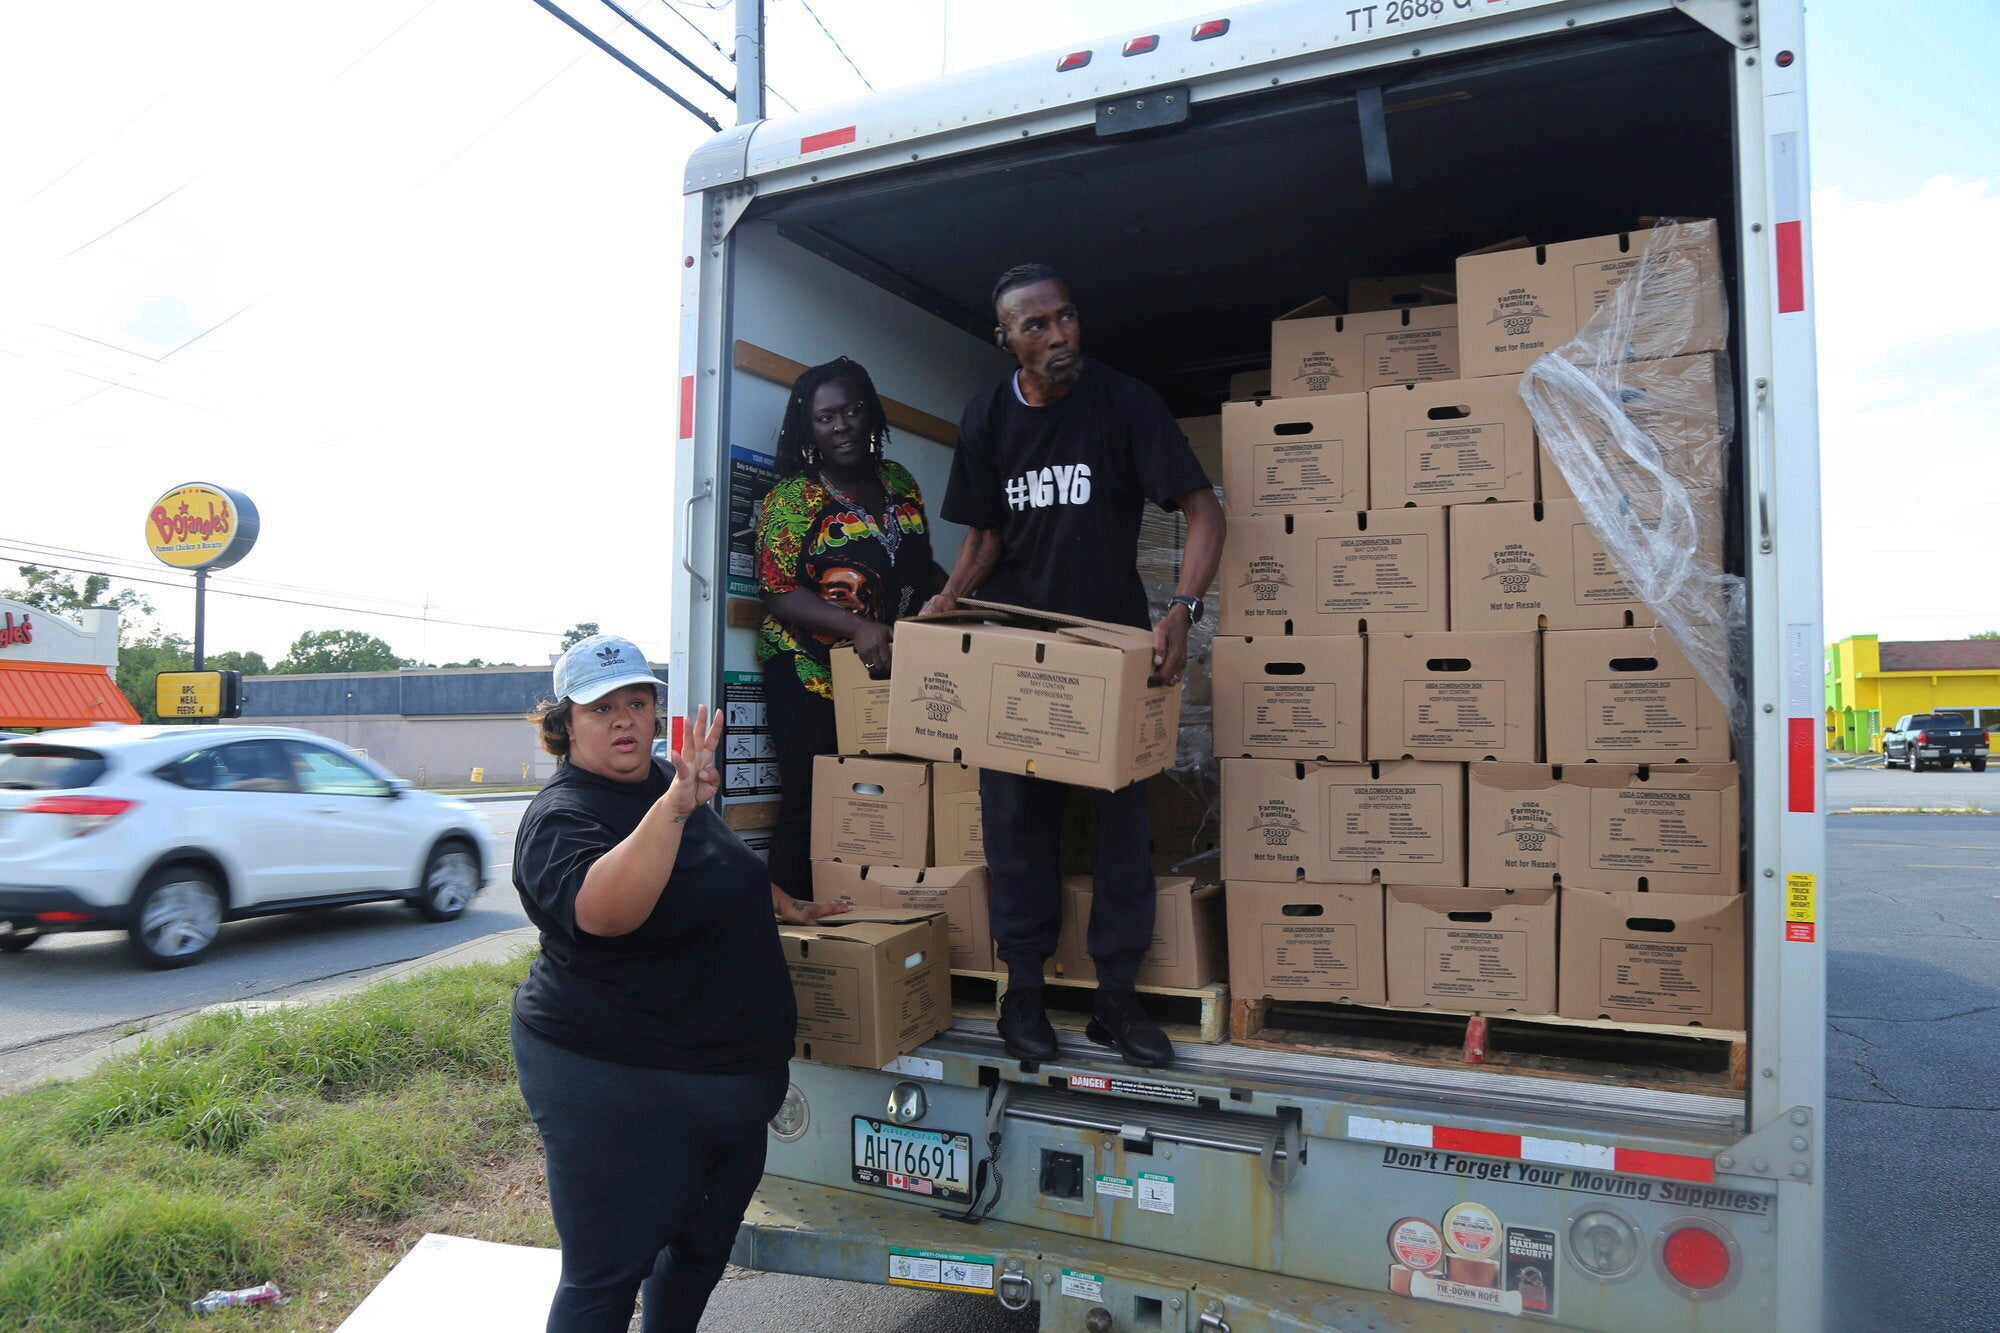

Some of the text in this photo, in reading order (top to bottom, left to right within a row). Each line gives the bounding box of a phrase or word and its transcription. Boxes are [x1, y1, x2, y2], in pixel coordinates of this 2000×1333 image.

[1346, 0, 1444, 32] TT 2688
[1497, 293, 1531, 303] Farmers
[1500, 299, 1534, 310] Families
[1503, 317, 1533, 328] FOOD
[1507, 325, 1531, 335] BOX
[1494, 340, 1544, 353] Not for Resale
[1306, 376, 1330, 384] FOOD
[1308, 382, 1328, 391] BOX
[1004, 463, 1092, 512] #IGY6
[1359, 553, 1398, 561] REFRIGERATED
[1494, 550, 1528, 558] Farmers
[1249, 560, 1278, 568] Farmers
[1496, 556, 1531, 565] Families
[1250, 566, 1281, 575] Families
[1499, 575, 1530, 585] FOOD
[1253, 584, 1279, 593] FOOD
[1504, 583, 1527, 594] BOX
[1256, 591, 1277, 601] BOX
[1490, 601, 1541, 611] Not for Resale
[1266, 608, 1288, 616] Resale
[600, 659, 625, 668] adidas
[933, 671, 949, 679] USDA
[1016, 670, 1080, 685] USDA COMBINATION BOX
[923, 676, 953, 687] Farmers
[1042, 681, 1065, 690] CONTAIN
[924, 683, 955, 695] Families
[1019, 687, 1074, 701] KEEP REFRIGERATED
[180, 696, 198, 705] MEAL
[176, 705, 204, 715] FEEDS 4
[925, 702, 952, 713] FOOD
[928, 711, 948, 723] BOX
[915, 726, 959, 741] Not for Resale
[1354, 787, 1369, 795] USDA
[1636, 792, 1677, 800] COMBINATION
[1258, 805, 1290, 813] Farmers
[1510, 807, 1545, 815] Farmers
[1640, 808, 1686, 816] REFRIGERATED
[1260, 811, 1292, 819] Families
[1512, 814, 1548, 823] Families
[1263, 829, 1290, 838] FOOD
[1515, 833, 1546, 842] FOOD
[1266, 836, 1288, 846] BOX
[1519, 841, 1543, 851] BOX
[1254, 853, 1300, 862] Not for Resale
[1505, 859, 1557, 869] Not for Resale
[1071, 1075, 1106, 1089] DANGER
[881, 1126, 940, 1142] ARIZONA
[864, 1134, 959, 1183] AH76691
[1143, 1173, 1169, 1182] ATTENTION
[1383, 1146, 1770, 1212] Don't Forget Your Moving Supplies!
[1509, 1239, 1553, 1252] MAXIMUM
[1509, 1246, 1553, 1260] SECURITY
[1436, 1283, 1476, 1298] TIE-DOWN
[1478, 1291, 1500, 1303] ROPE
